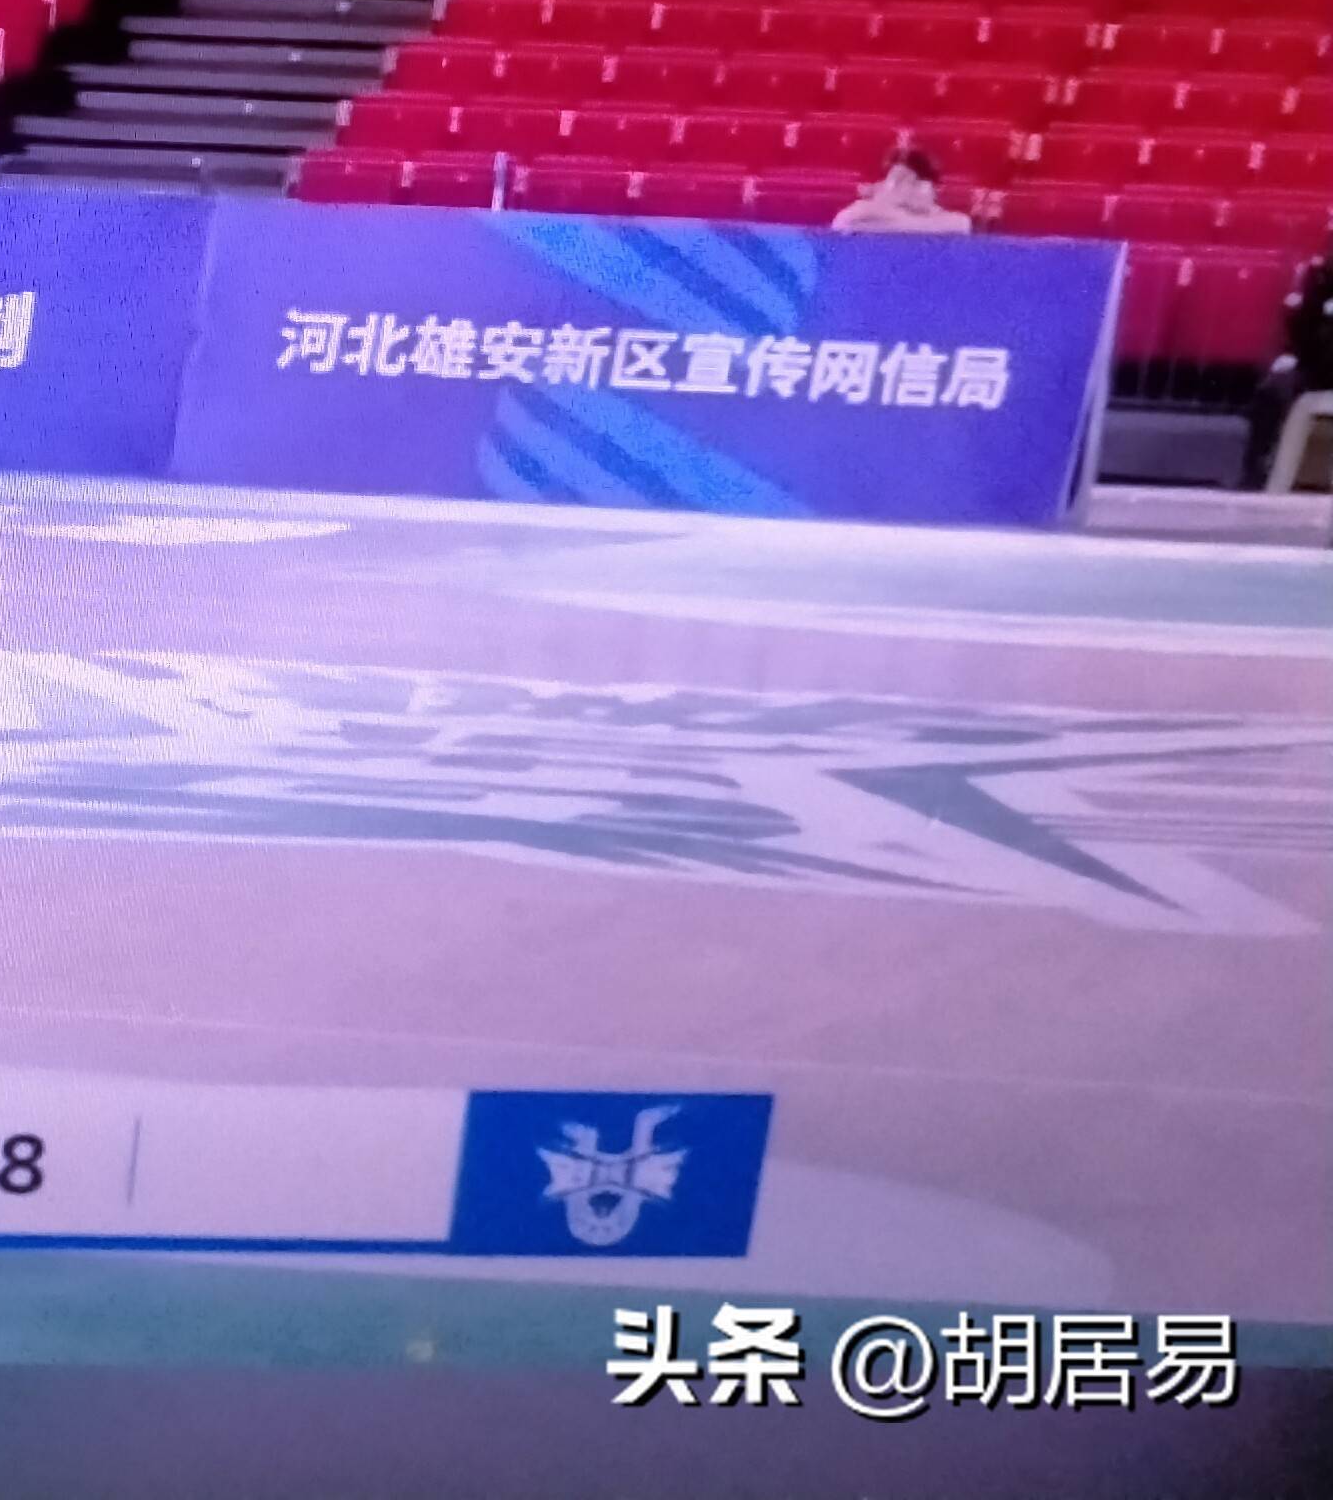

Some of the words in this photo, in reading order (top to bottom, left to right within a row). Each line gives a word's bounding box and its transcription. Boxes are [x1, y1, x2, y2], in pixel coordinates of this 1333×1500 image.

[274, 305, 1011, 411] 河北雄安新区宣传网信局
